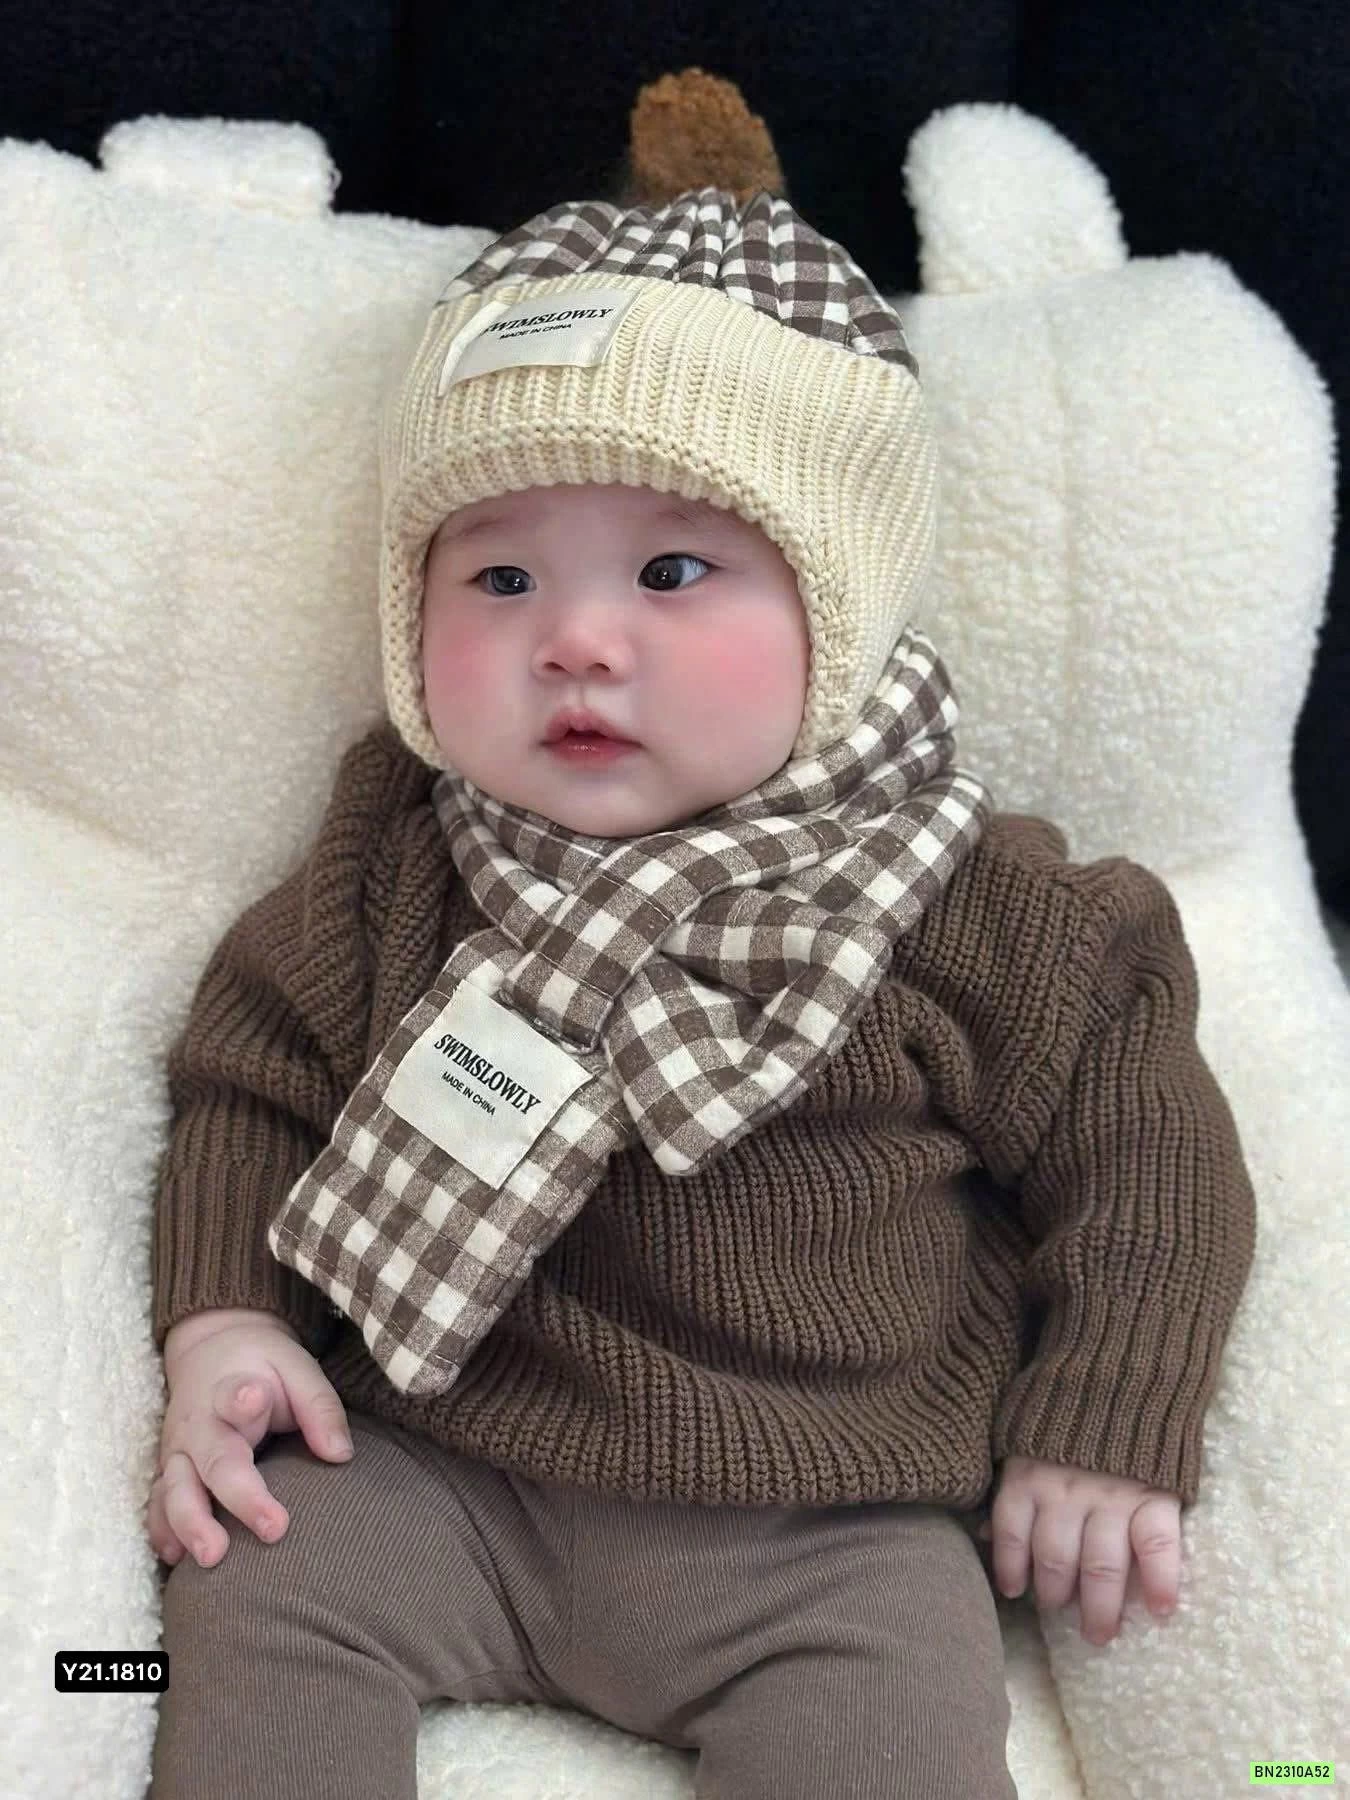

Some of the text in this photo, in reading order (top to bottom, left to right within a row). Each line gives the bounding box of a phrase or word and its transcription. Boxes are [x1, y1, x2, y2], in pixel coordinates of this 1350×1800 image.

[499, 331, 530, 340] MADE
[542, 323, 572, 332] CHINA
[434, 1033, 541, 1115] SWIMSLOWLY
[441, 1071, 496, 1115] MADE IN CHINA
